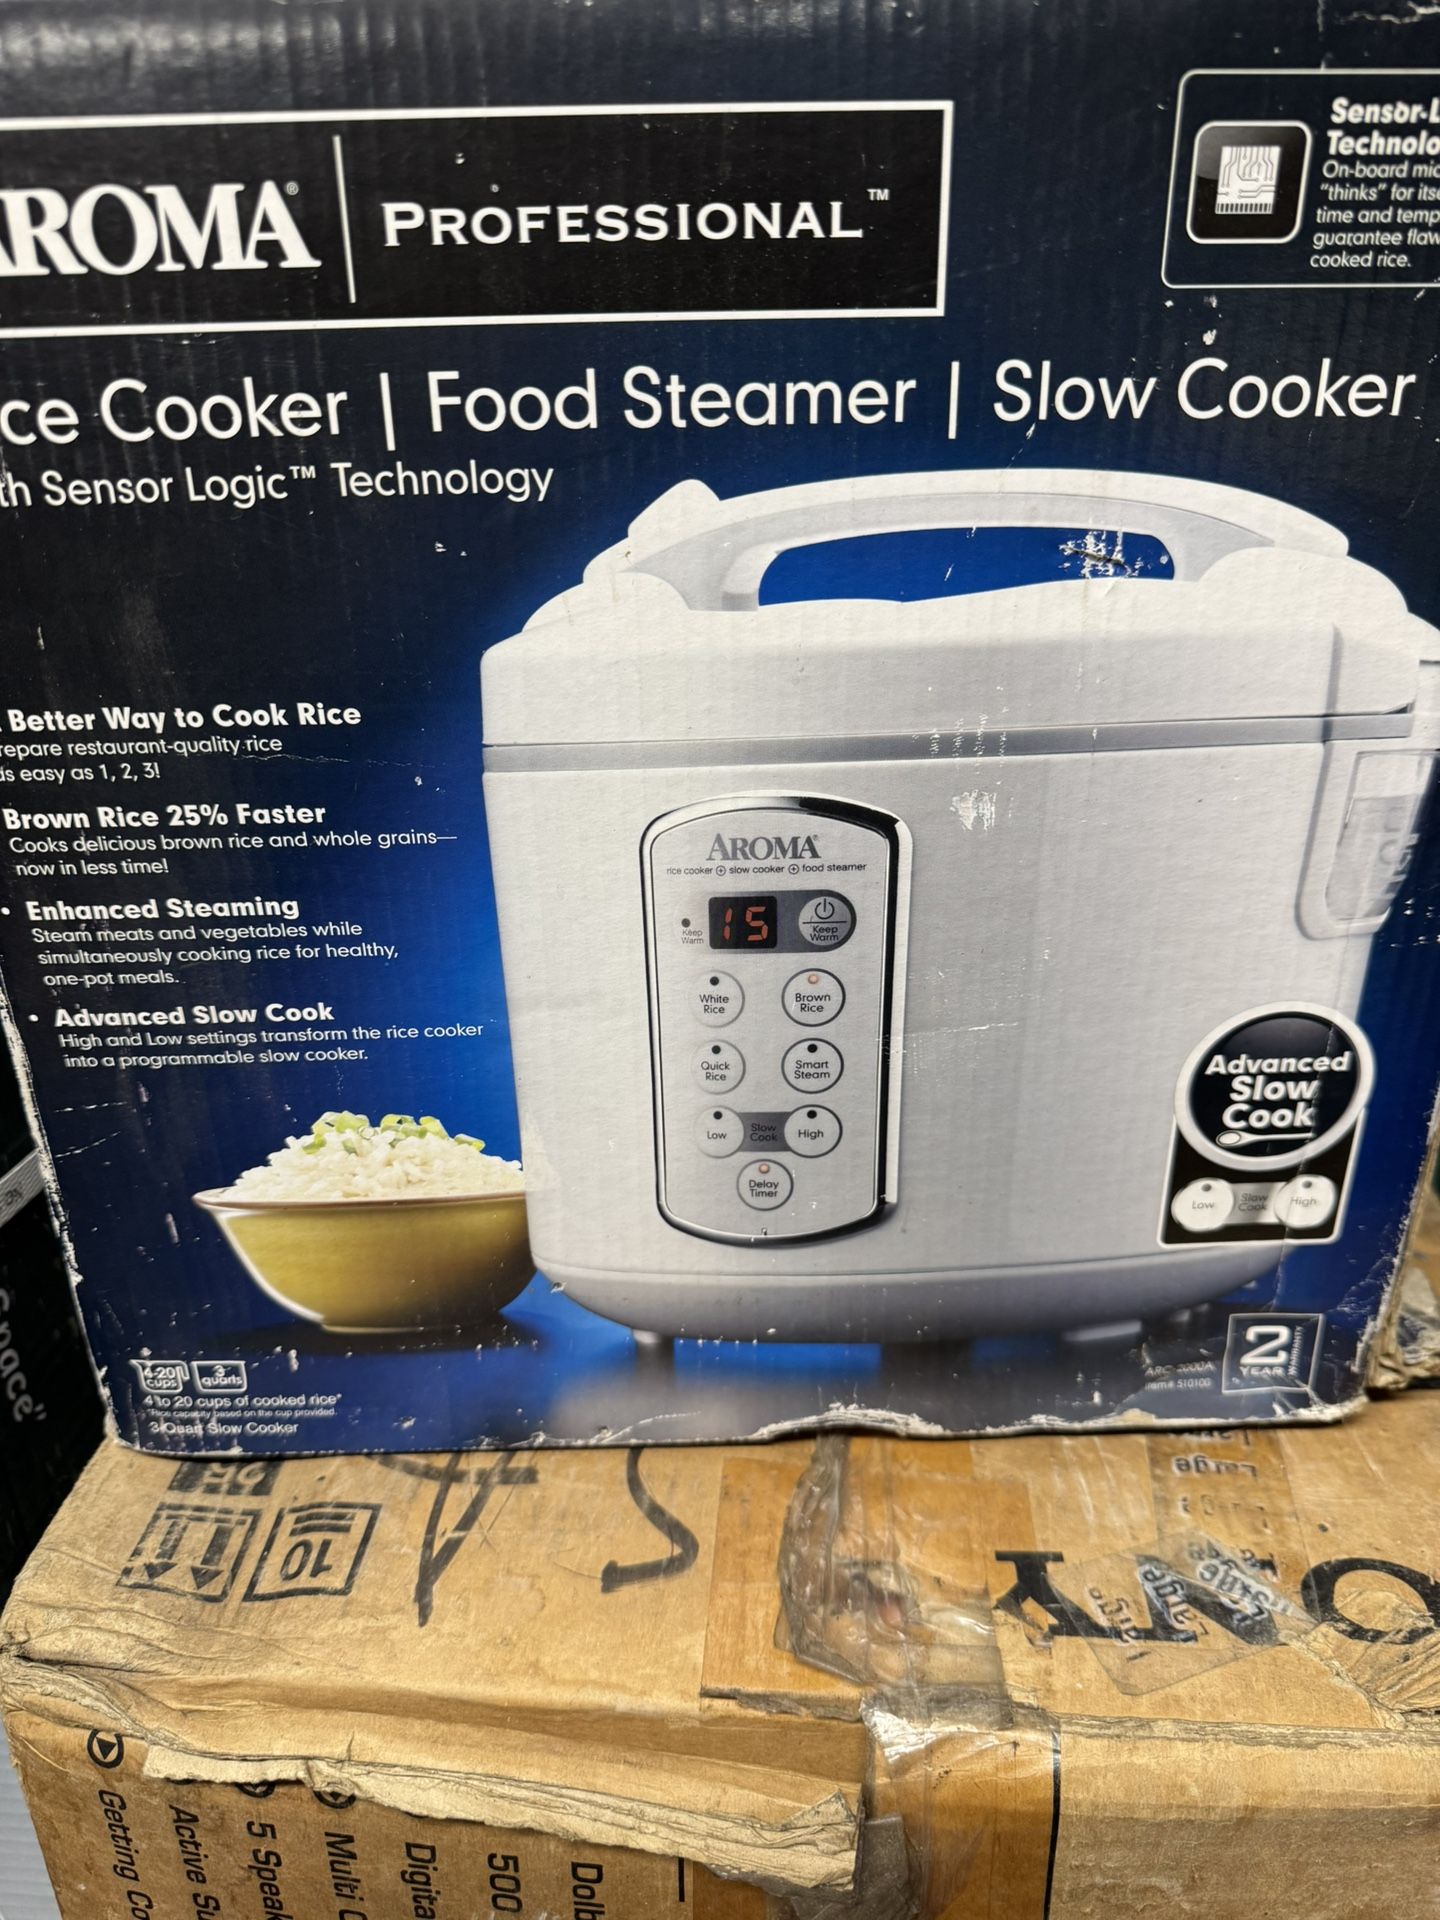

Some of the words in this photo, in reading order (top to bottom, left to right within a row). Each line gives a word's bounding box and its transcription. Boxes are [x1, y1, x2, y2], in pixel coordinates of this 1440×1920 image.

[1327, 129, 1440, 156] Technolo
[1322, 159, 1408, 179] On-board
[1412, 159, 1440, 178] mic
[1320, 182, 1387, 201] “thinks”
[1390, 183, 1415, 201] for
[1316, 205, 1354, 223] time
[1357, 205, 1393, 223] and
[1396, 208, 1440, 227] temp
[0, 181, 322, 277] ROMA®
[1312, 230, 1403, 250] guarantee
[1310, 250, 1373, 268] cooked
[1376, 250, 1412, 268] rice.
[101, 377, 347, 442] Cooker
[428, 368, 599, 433] Food
[623, 364, 916, 430] Steamer
[993, 358, 1157, 421] Slow
[1178, 357, 1416, 420] Cooker
[41, 470, 173, 506] Sensor
[330, 459, 554, 503] Technology
[7, 709, 96, 732] Better
[101, 707, 166, 734] Way
[174, 708, 204, 728] to
[212, 703, 289, 728] Cook
[297, 702, 361, 726] Rice
[67, 736, 240, 757] restaurant-quality
[245, 735, 283, 751] rice
[20, 768, 65, 786] easy
[71, 767, 94, 781] as
[99, 764, 116, 783] 1,
[120, 763, 138, 783] 2,
[143, 762, 161, 779] 3!
[2, 808, 90, 830] Brown
[97, 806, 159, 828] Rice
[166, 804, 228, 827] 25%
[235, 803, 326, 825] Faster
[9, 837, 68, 853] Cooks
[73, 834, 157, 852] delicious
[160, 834, 222, 850] brown
[228, 833, 263, 848] rice
[269, 831, 308, 848] and
[313, 830, 372, 847] whole
[16, 863, 55, 876] now
[59, 861, 77, 875] in
[80, 860, 118, 875] less
[121, 858, 169, 874] time!
[666, 867, 682, 875] rice
[684, 865, 713, 875] cooker
[729, 865, 750, 874] slow
[753, 863, 784, 873] cooker
[802, 863, 824, 872] food
[827, 862, 866, 872] steamer
[26, 899, 159, 921] Enhanced
[166, 896, 300, 920] Steaming
[31, 928, 92, 943] Steam
[96, 928, 154, 942] meats
[158, 925, 196, 941] and
[201, 923, 308, 942] vegetables
[312, 921, 363, 936] while
[722, 905, 769, 941] 15
[813, 924, 838, 936] Keep
[682, 929, 703, 937] Keep
[810, 933, 839, 942] Warm
[38, 948, 173, 965] simultaneously
[176, 947, 251, 963] cooking
[256, 946, 290, 960] rice
[296, 945, 320, 959] for
[325, 942, 399, 959] healthy,
[43, 972, 114, 988] one-pot
[118, 970, 179, 984] meals.
[699, 994, 729, 1004] White
[795, 992, 831, 1002] Brown
[55, 1006, 186, 1027] Advanced
[192, 1005, 258, 1024] Slow
[265, 1002, 335, 1022] Cook
[703, 1004, 725, 1014] Rice
[800, 1003, 824, 1013] Rice
[59, 1033, 102, 1050] High
[106, 1033, 142, 1046] and
[147, 1033, 182, 1045] Low
[187, 1031, 257, 1047] settings
[261, 1027, 347, 1043] transform
[352, 1026, 381, 1040] the
[387, 1025, 419, 1039] rice
[424, 1023, 484, 1038] cooker
[64, 1055, 98, 1068] into
[101, 1057, 115, 1067] a
[119, 1050, 255, 1069] programmable
[260, 1049, 299, 1063] slow
[305, 1047, 368, 1062] cooker.
[700, 1061, 730, 1071] Quick
[795, 1059, 829, 1069] Smart
[1204, 1050, 1353, 1076] Advanced
[705, 1071, 727, 1081] Rice
[794, 1069, 831, 1079] Steam
[1229, 1074, 1320, 1103] Slow
[1222, 1102, 1315, 1131] Cook
[706, 1130, 727, 1139] Low
[751, 1122, 777, 1132] Slow
[798, 1129, 824, 1140] High
[750, 1132, 778, 1142] Cook
[749, 1179, 779, 1190] Delay
[750, 1188, 778, 1198] Timer
[1192, 1199, 1215, 1210] Low
[1290, 1196, 1317, 1208] High
[1239, 1325, 1292, 1366] 2
[143, 1367, 175, 1379] 4-20
[214, 1365, 226, 1378] 3
[1239, 1366, 1286, 1377] YEAR
[146, 1378, 177, 1389] cups
[202, 1375, 243, 1387] quarts
[143, 1395, 153, 1407] 4
[174, 1395, 193, 1407] 20
[198, 1396, 231, 1409] cups
[236, 1394, 249, 1406] of
[253, 1394, 305, 1407] cooked
[207, 1421, 242, 1434] Slow
[247, 1421, 299, 1433] Cooker
[280, 1539, 332, 1581] 10
[97, 1788, 140, 1883] Getting
[247, 1821, 277, 1840] 5
[169, 1804, 208, 1885] Active
[324, 1831, 364, 1901] Multi
[487, 1853, 523, 1914] 500
